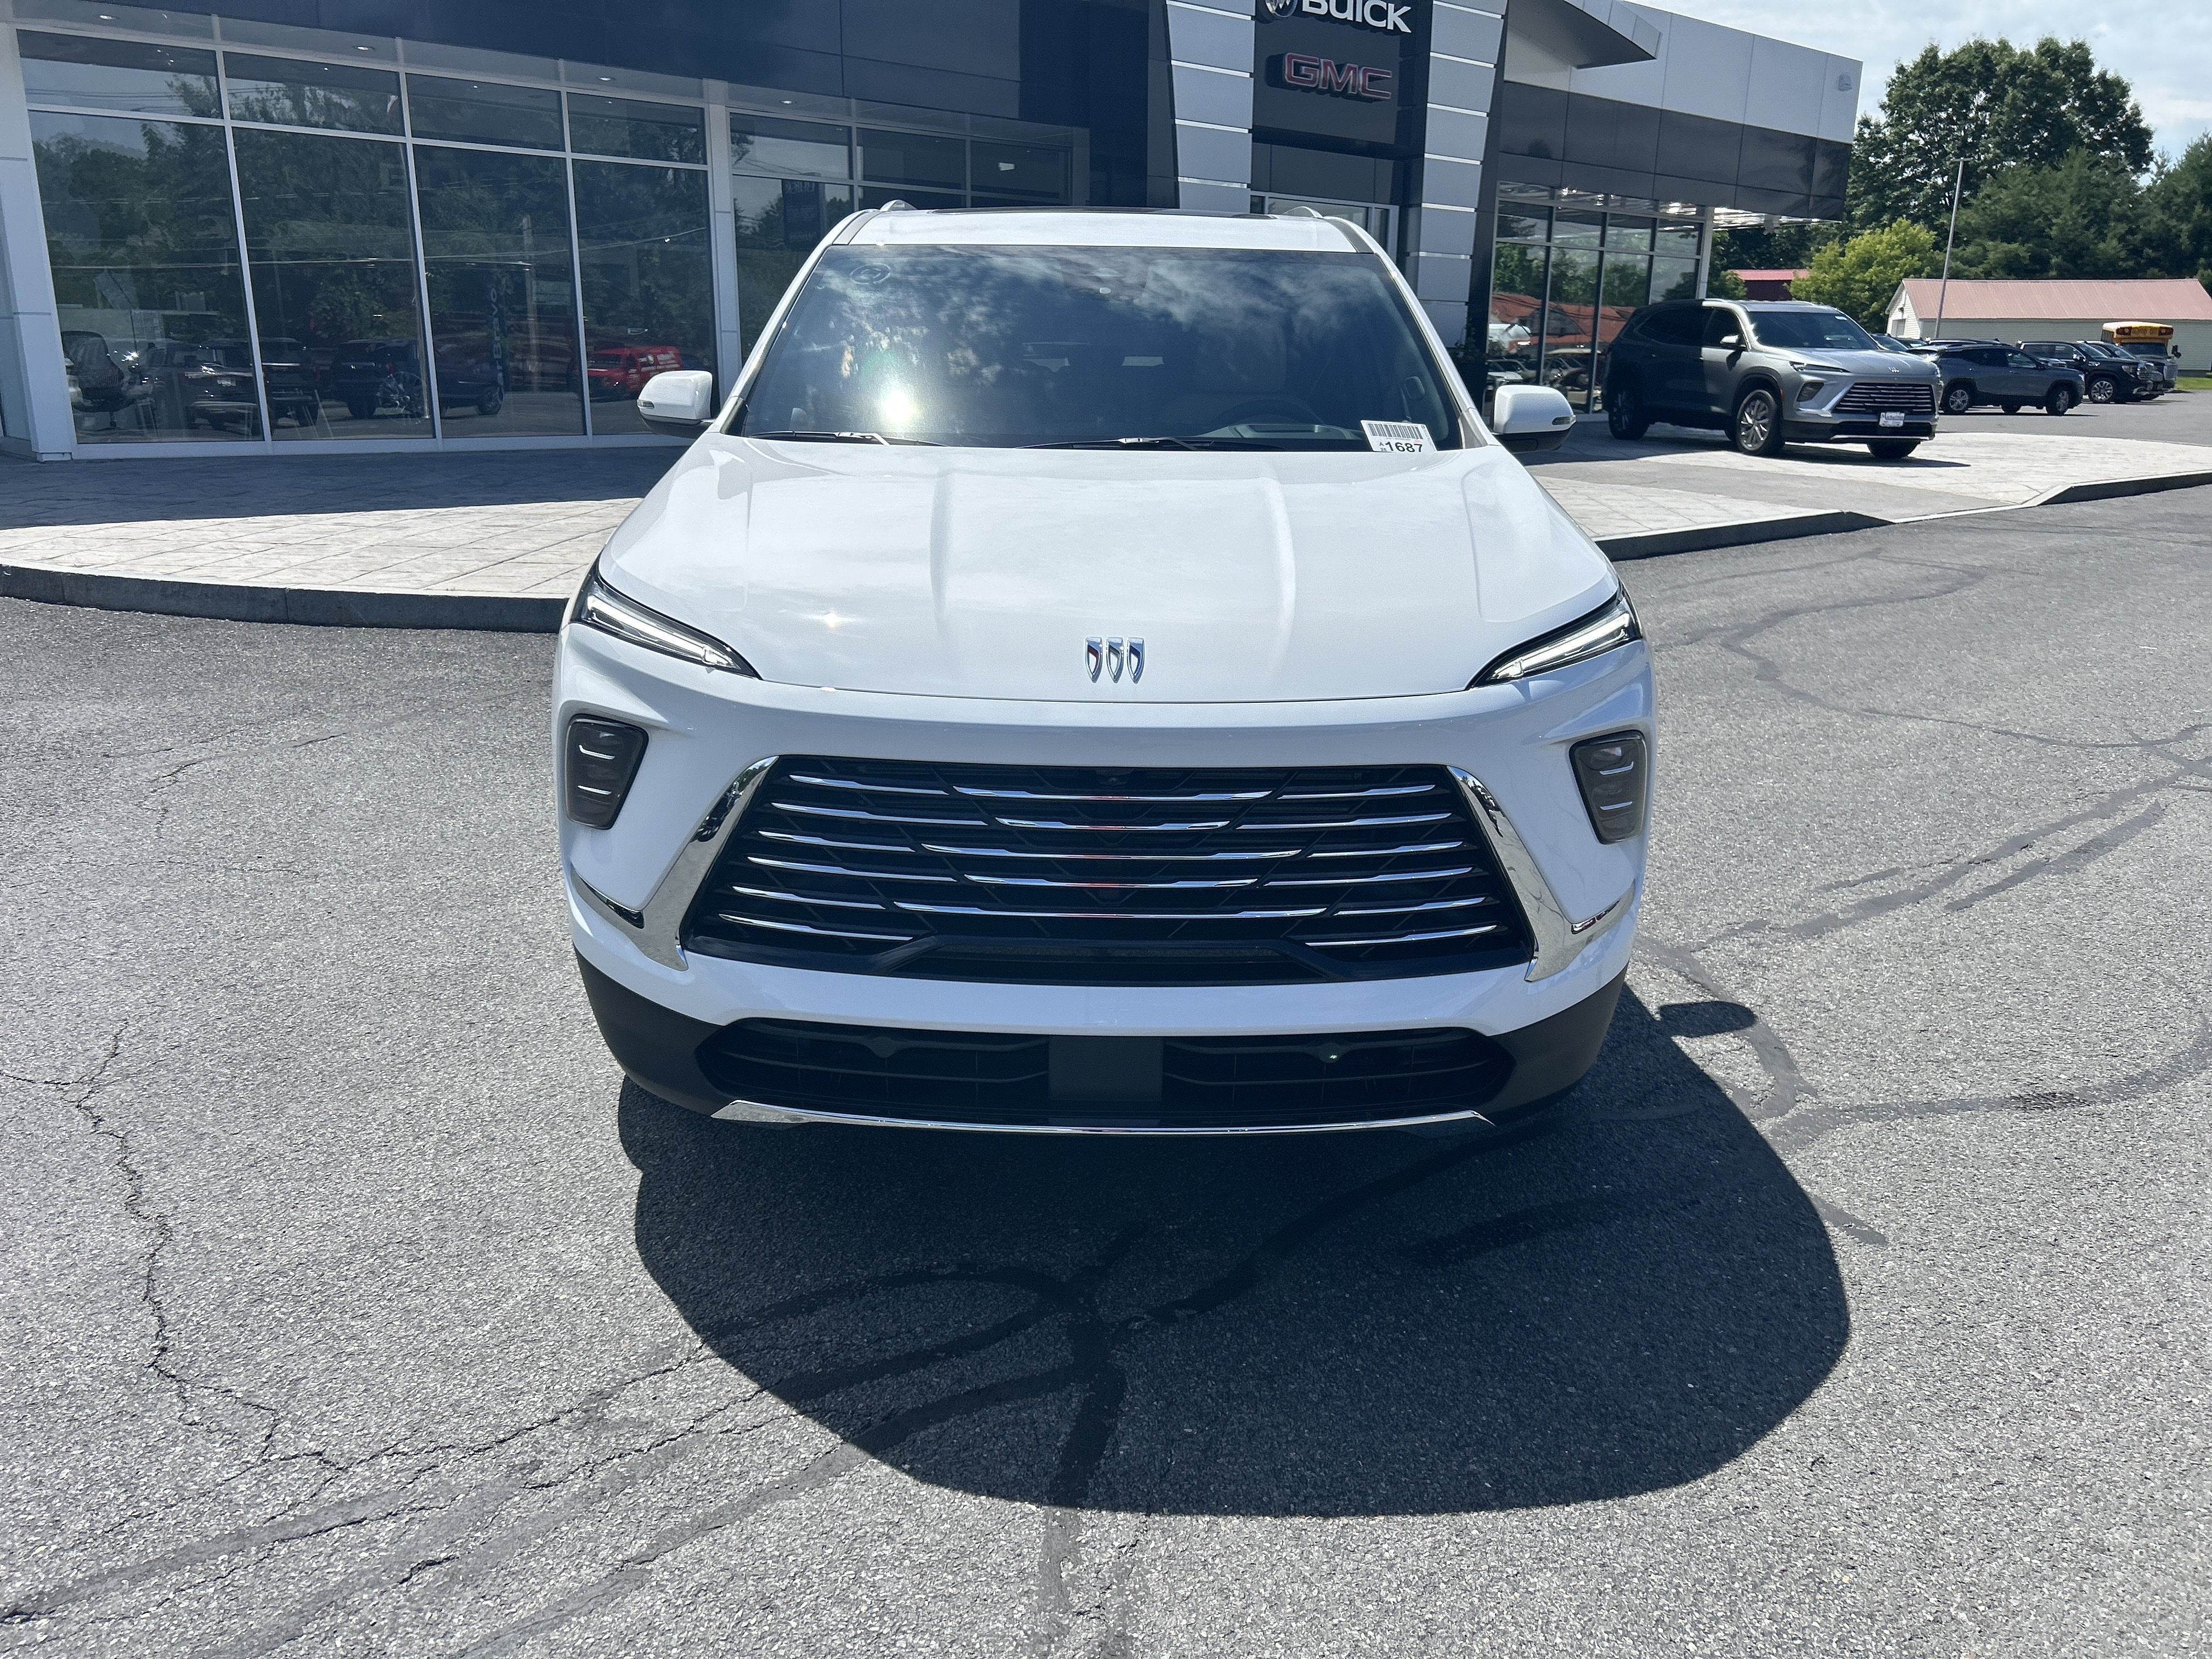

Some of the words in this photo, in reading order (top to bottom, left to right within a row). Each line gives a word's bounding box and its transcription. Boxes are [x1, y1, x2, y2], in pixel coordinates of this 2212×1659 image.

[1302, 0, 1412, 33] BUICK
[1284, 53, 1392, 99] GMC
[1385, 441, 1423, 452] 1687
